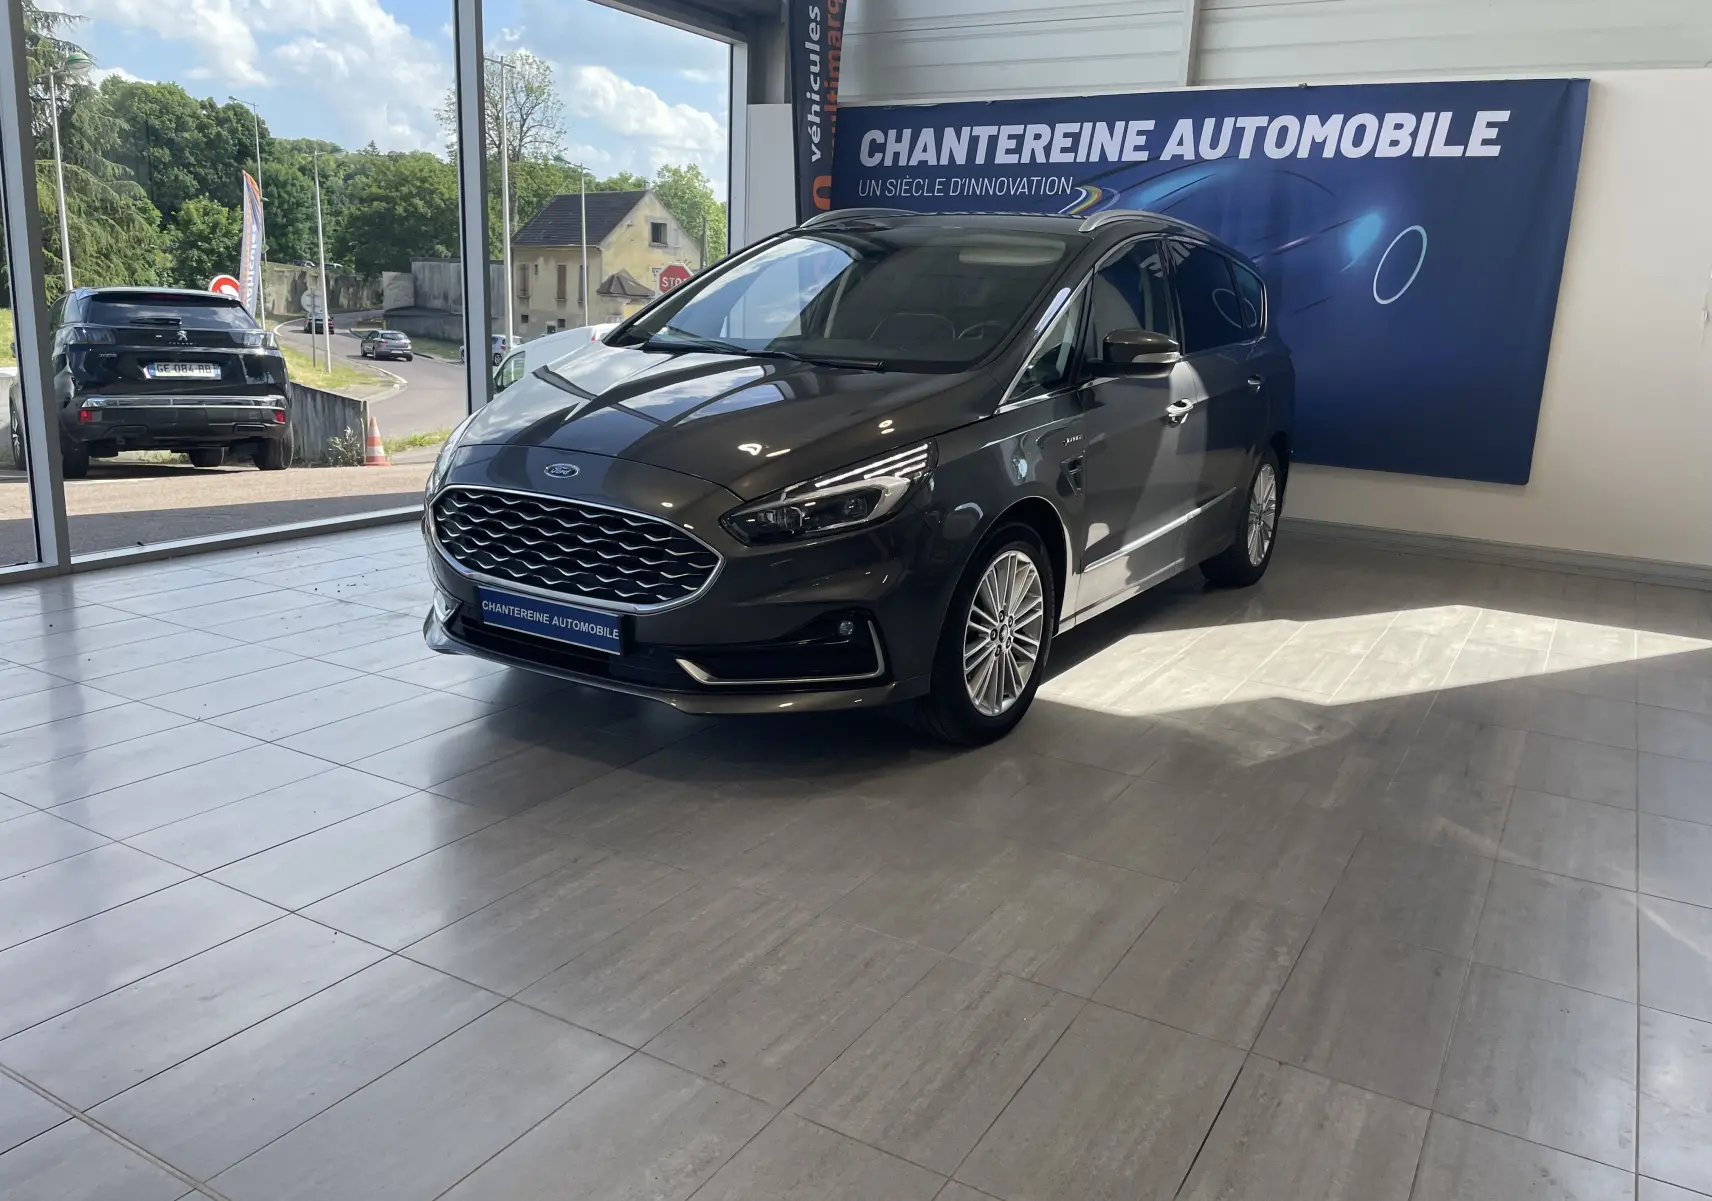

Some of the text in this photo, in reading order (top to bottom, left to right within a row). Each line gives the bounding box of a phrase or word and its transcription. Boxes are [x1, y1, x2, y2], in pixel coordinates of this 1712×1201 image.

[805, 5, 823, 162] véhicules
[859, 110, 1511, 167] CHANTEREINE AUTOMOBILE
[858, 174, 1074, 197] UN SIÈCLE D'INNOVATION
[662, 276, 687, 288] STO
[482, 600, 620, 640] CHANTEREINE AUTOMOBILE
